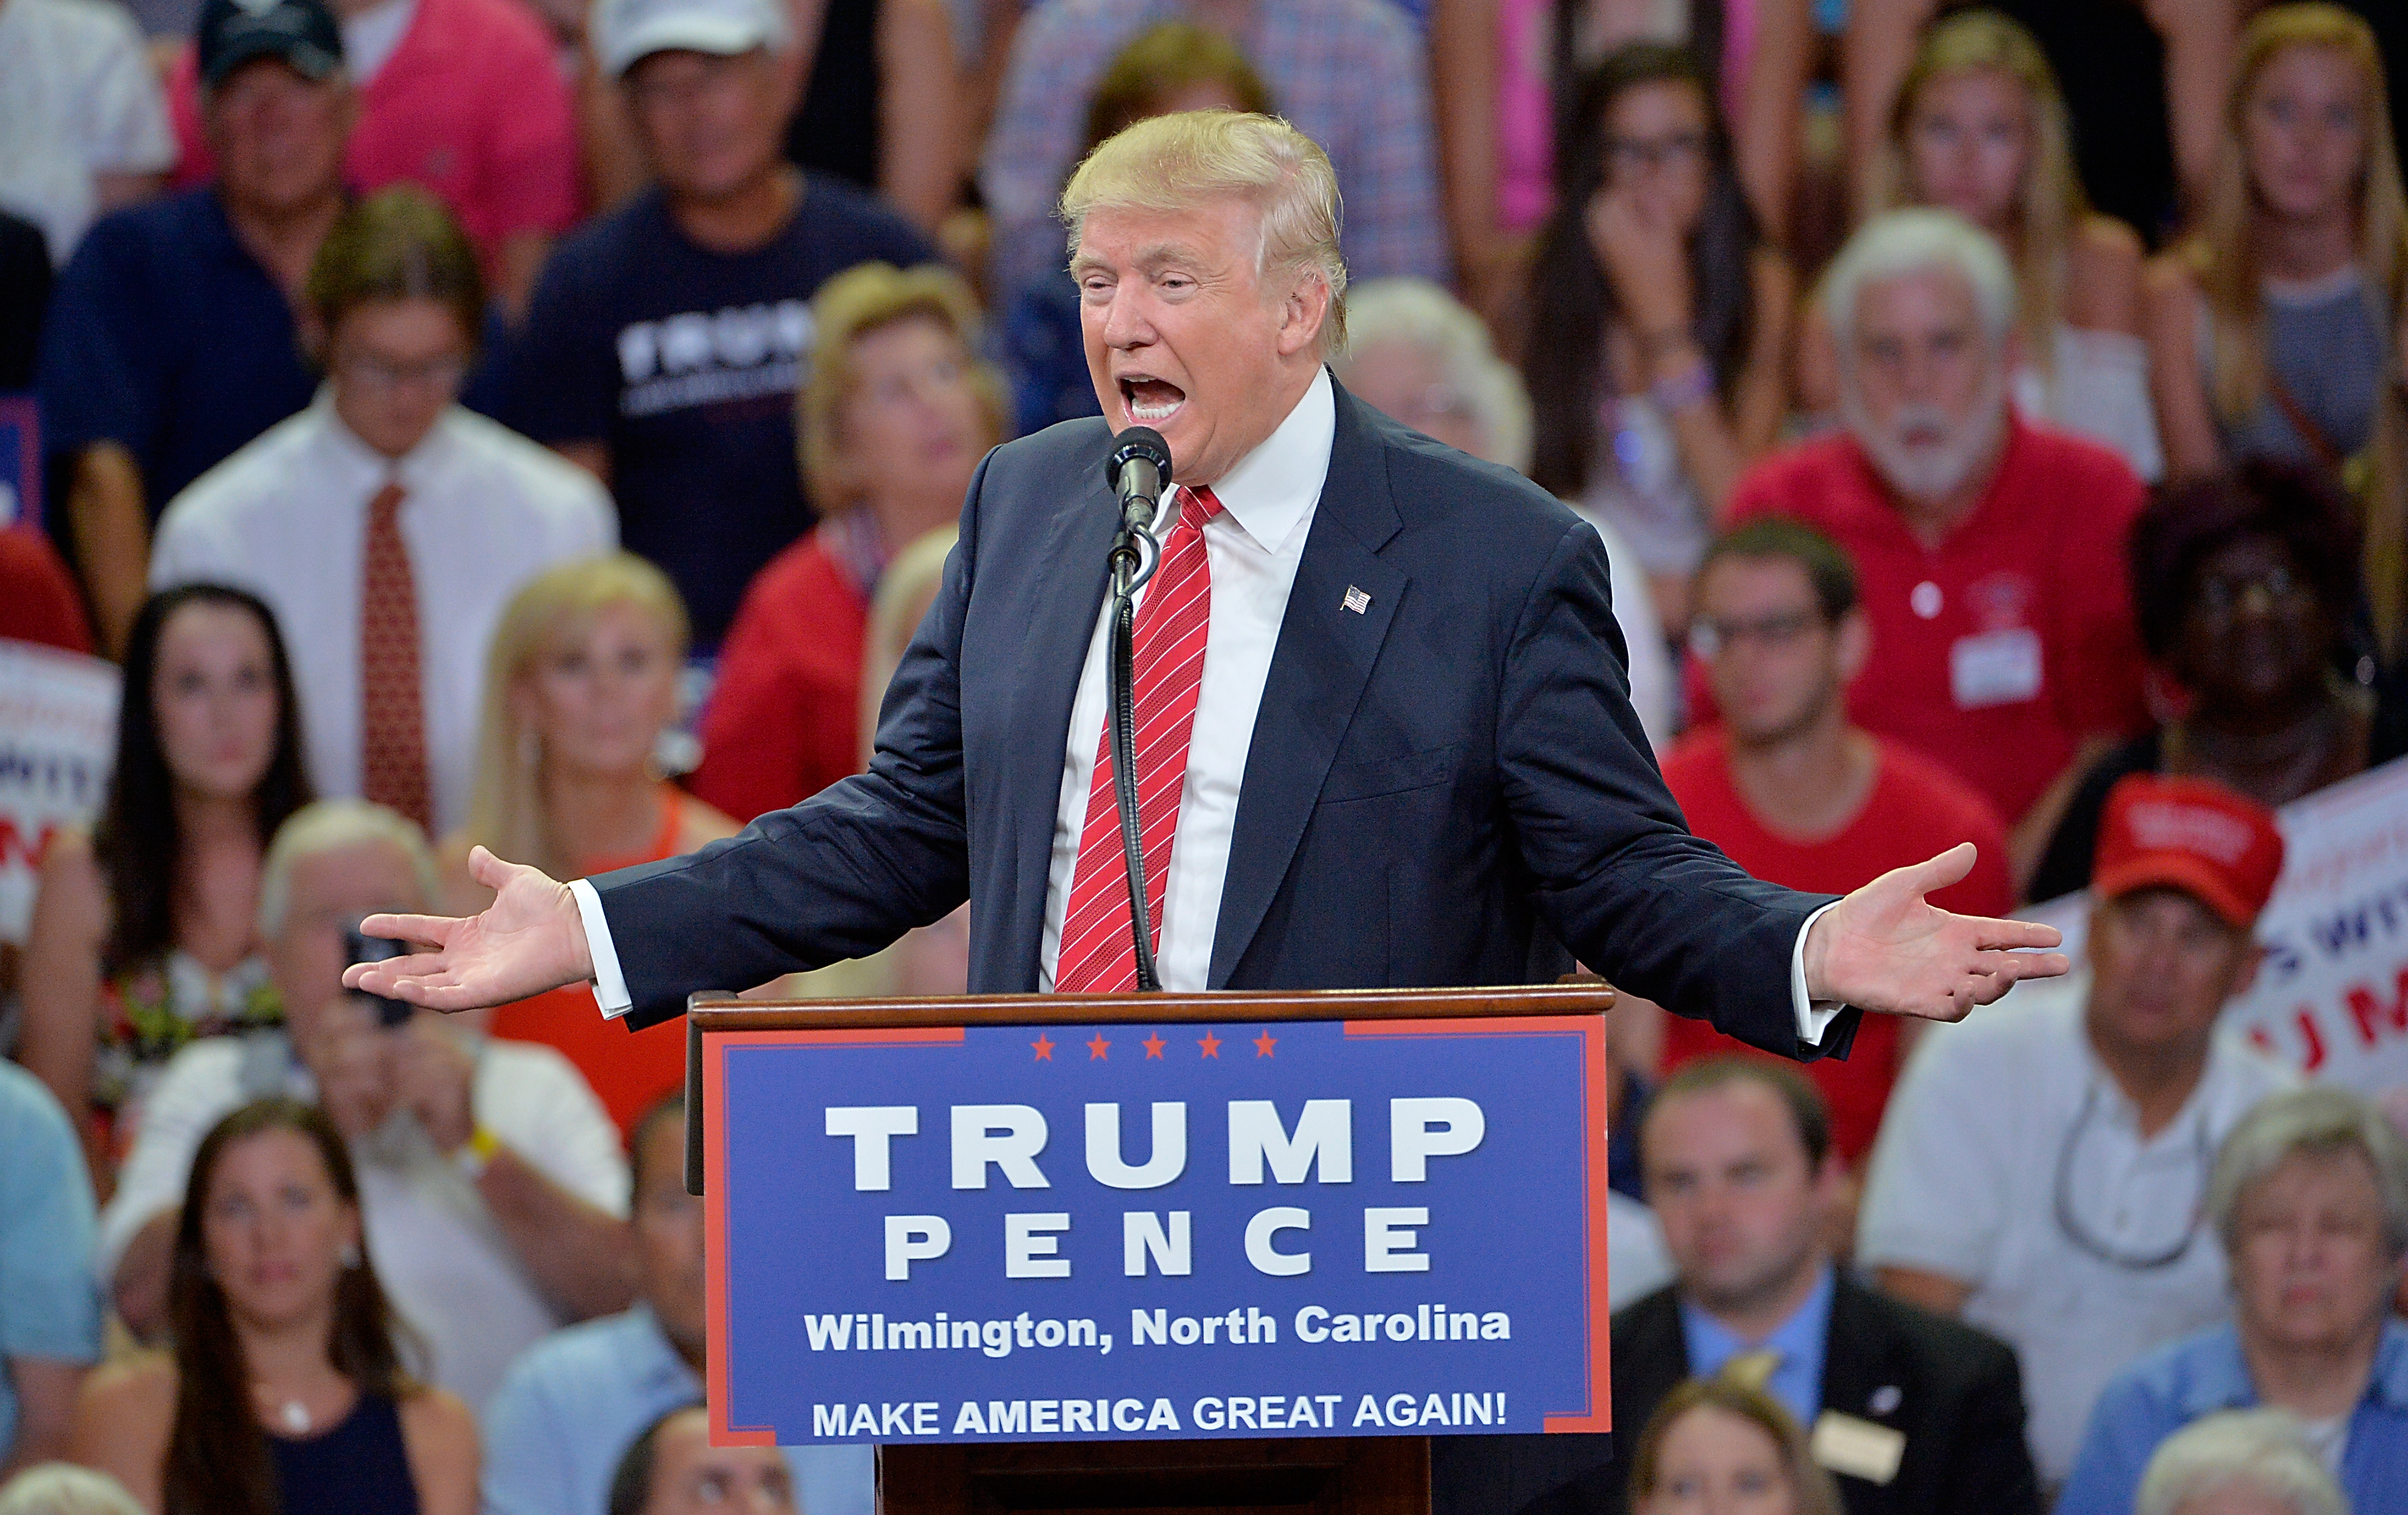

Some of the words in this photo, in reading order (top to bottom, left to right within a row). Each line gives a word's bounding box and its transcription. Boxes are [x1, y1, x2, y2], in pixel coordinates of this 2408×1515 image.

[824, 1097, 1486, 1191] TRUMP
[885, 1207, 1430, 1281] PENCE
[804, 1312, 1112, 1358] Wilmington,
[1132, 1307, 1277, 1345] North
[1295, 1304, 1511, 1343] Carolina
[813, 1402, 940, 1436] MAKE
[952, 1398, 1180, 1435] AMERICA
[1193, 1395, 1343, 1431] GREAT
[1352, 1392, 1506, 1428] AGAIN!
